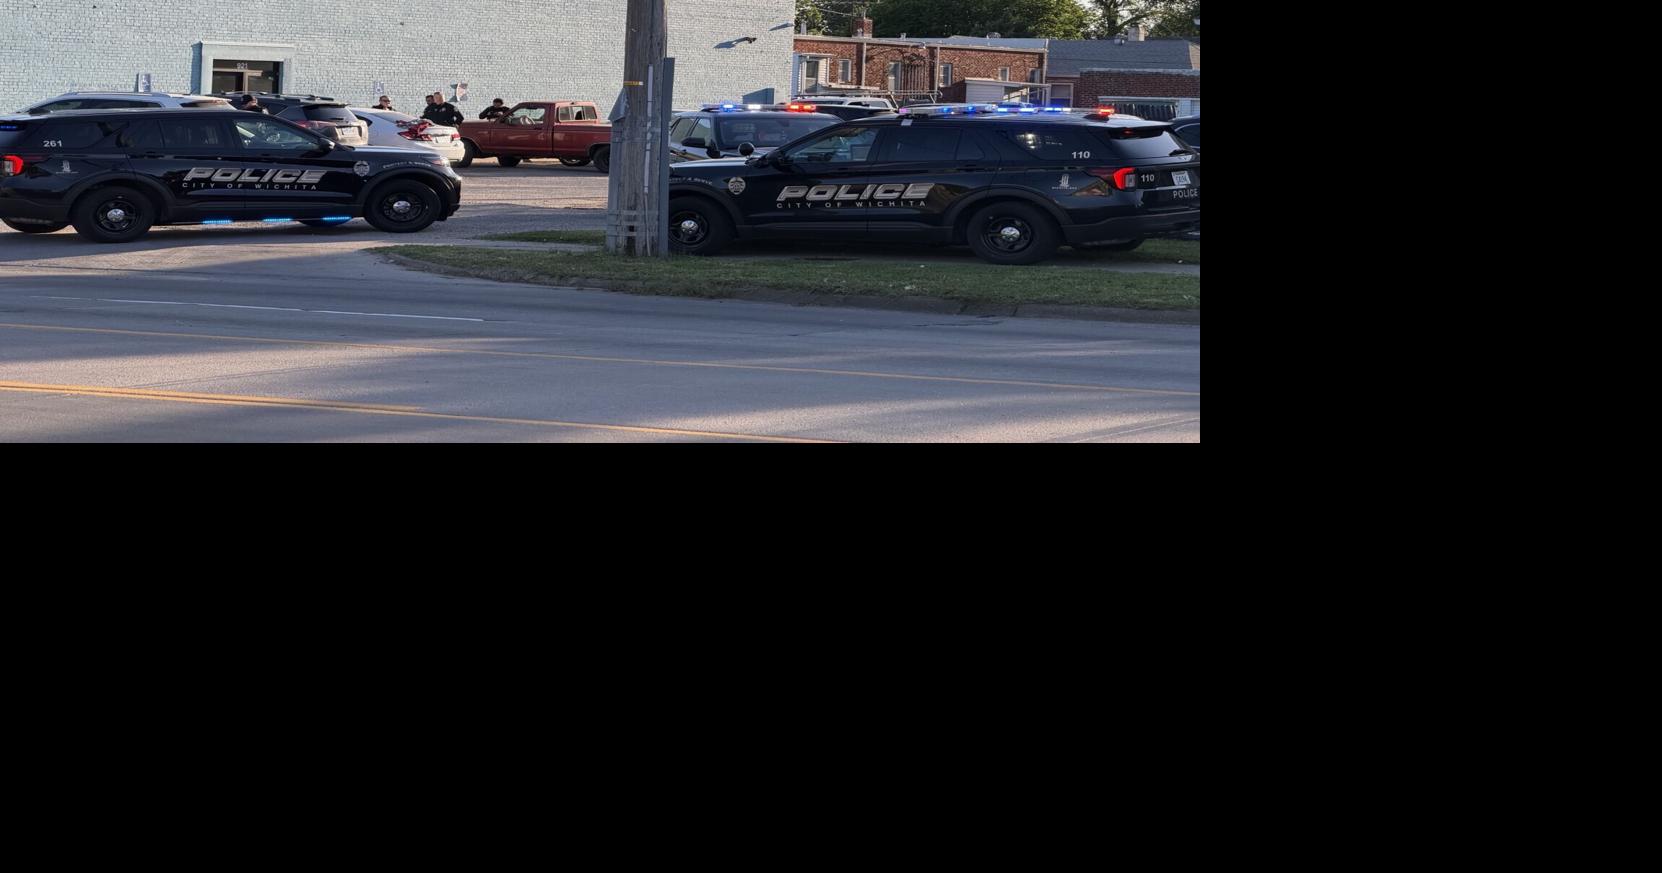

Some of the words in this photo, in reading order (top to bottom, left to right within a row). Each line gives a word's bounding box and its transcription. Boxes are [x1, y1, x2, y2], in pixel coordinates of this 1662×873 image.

[1072, 151, 1090, 159] 110
[183, 167, 327, 183] POLICE
[1141, 174, 1155, 182] 110
[776, 183, 935, 201] POLICE
[1172, 188, 1198, 198] POLICE
